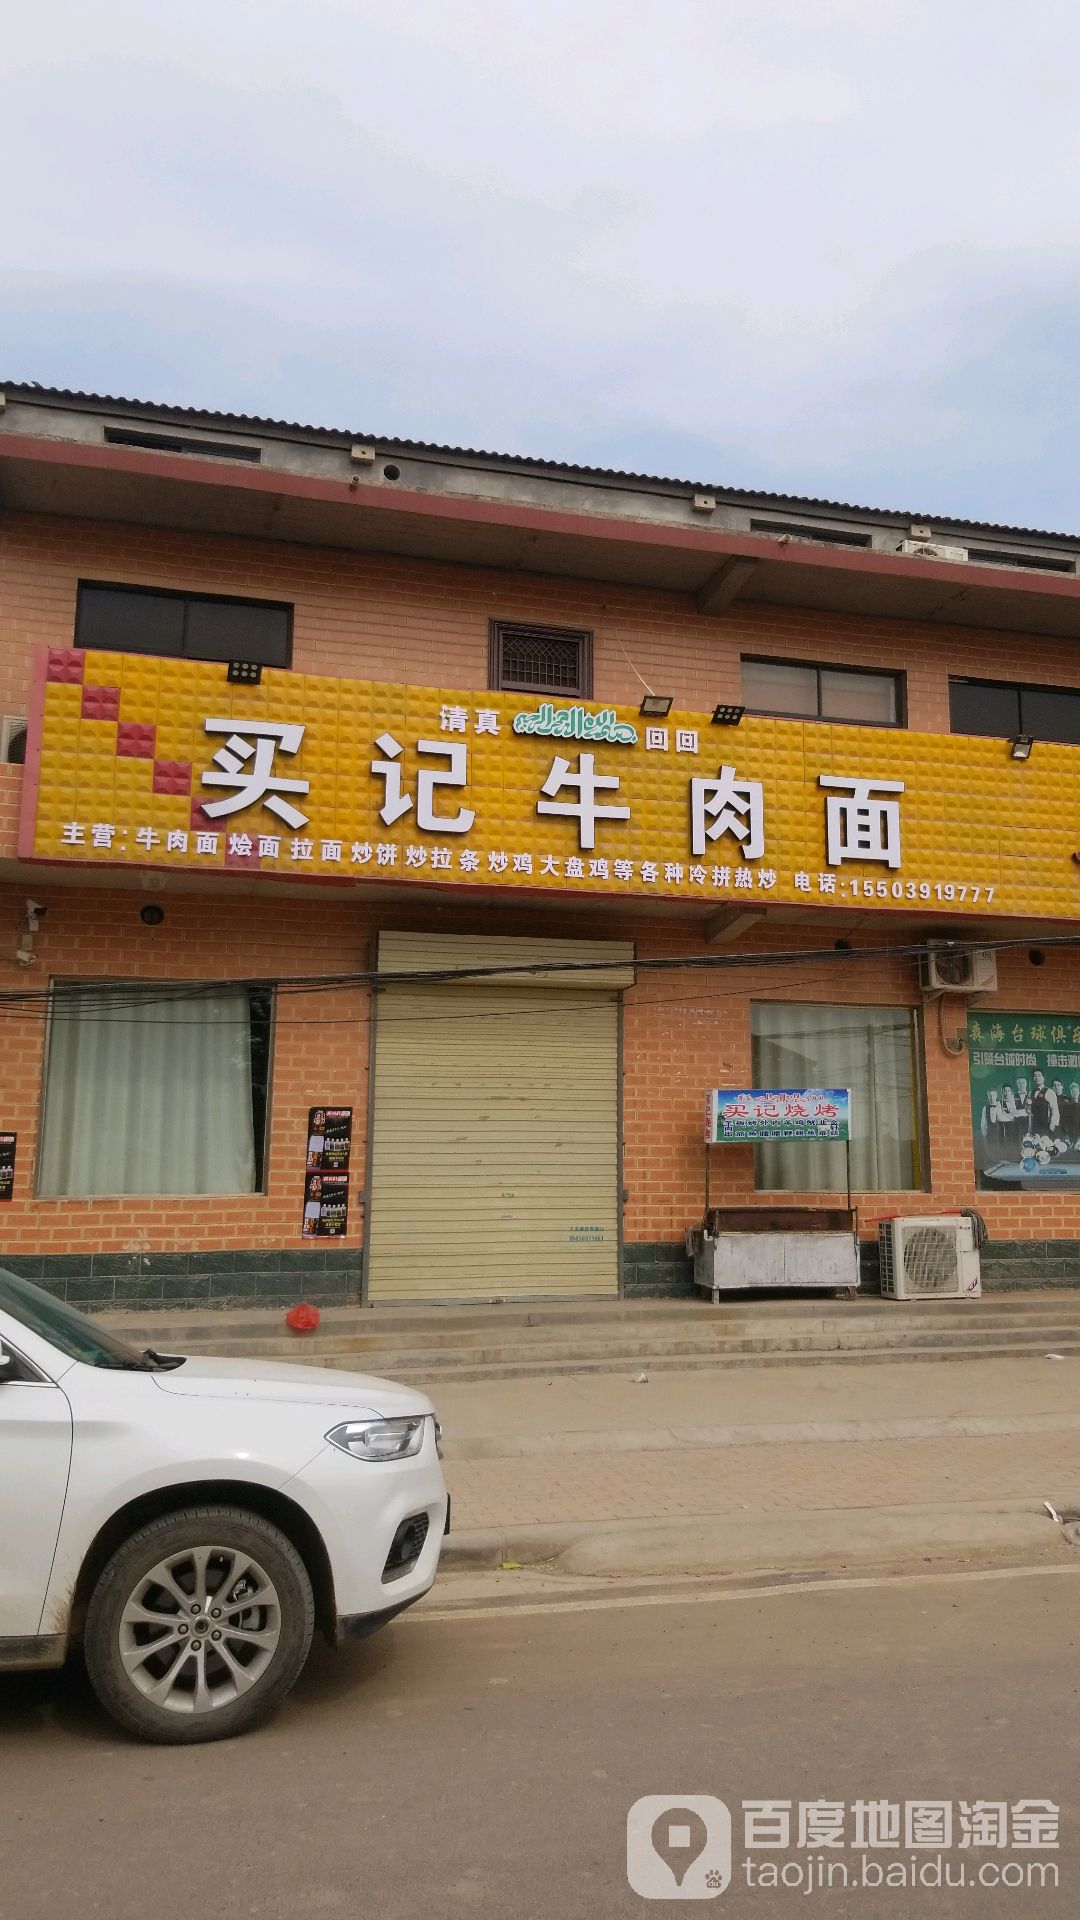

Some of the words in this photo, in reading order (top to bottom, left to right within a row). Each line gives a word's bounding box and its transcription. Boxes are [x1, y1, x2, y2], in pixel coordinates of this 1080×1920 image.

[439, 705, 501, 736] 清真
[201, 718, 905, 869] 买记牛肉面
[723, 1103, 840, 1118] 买记烧烤
